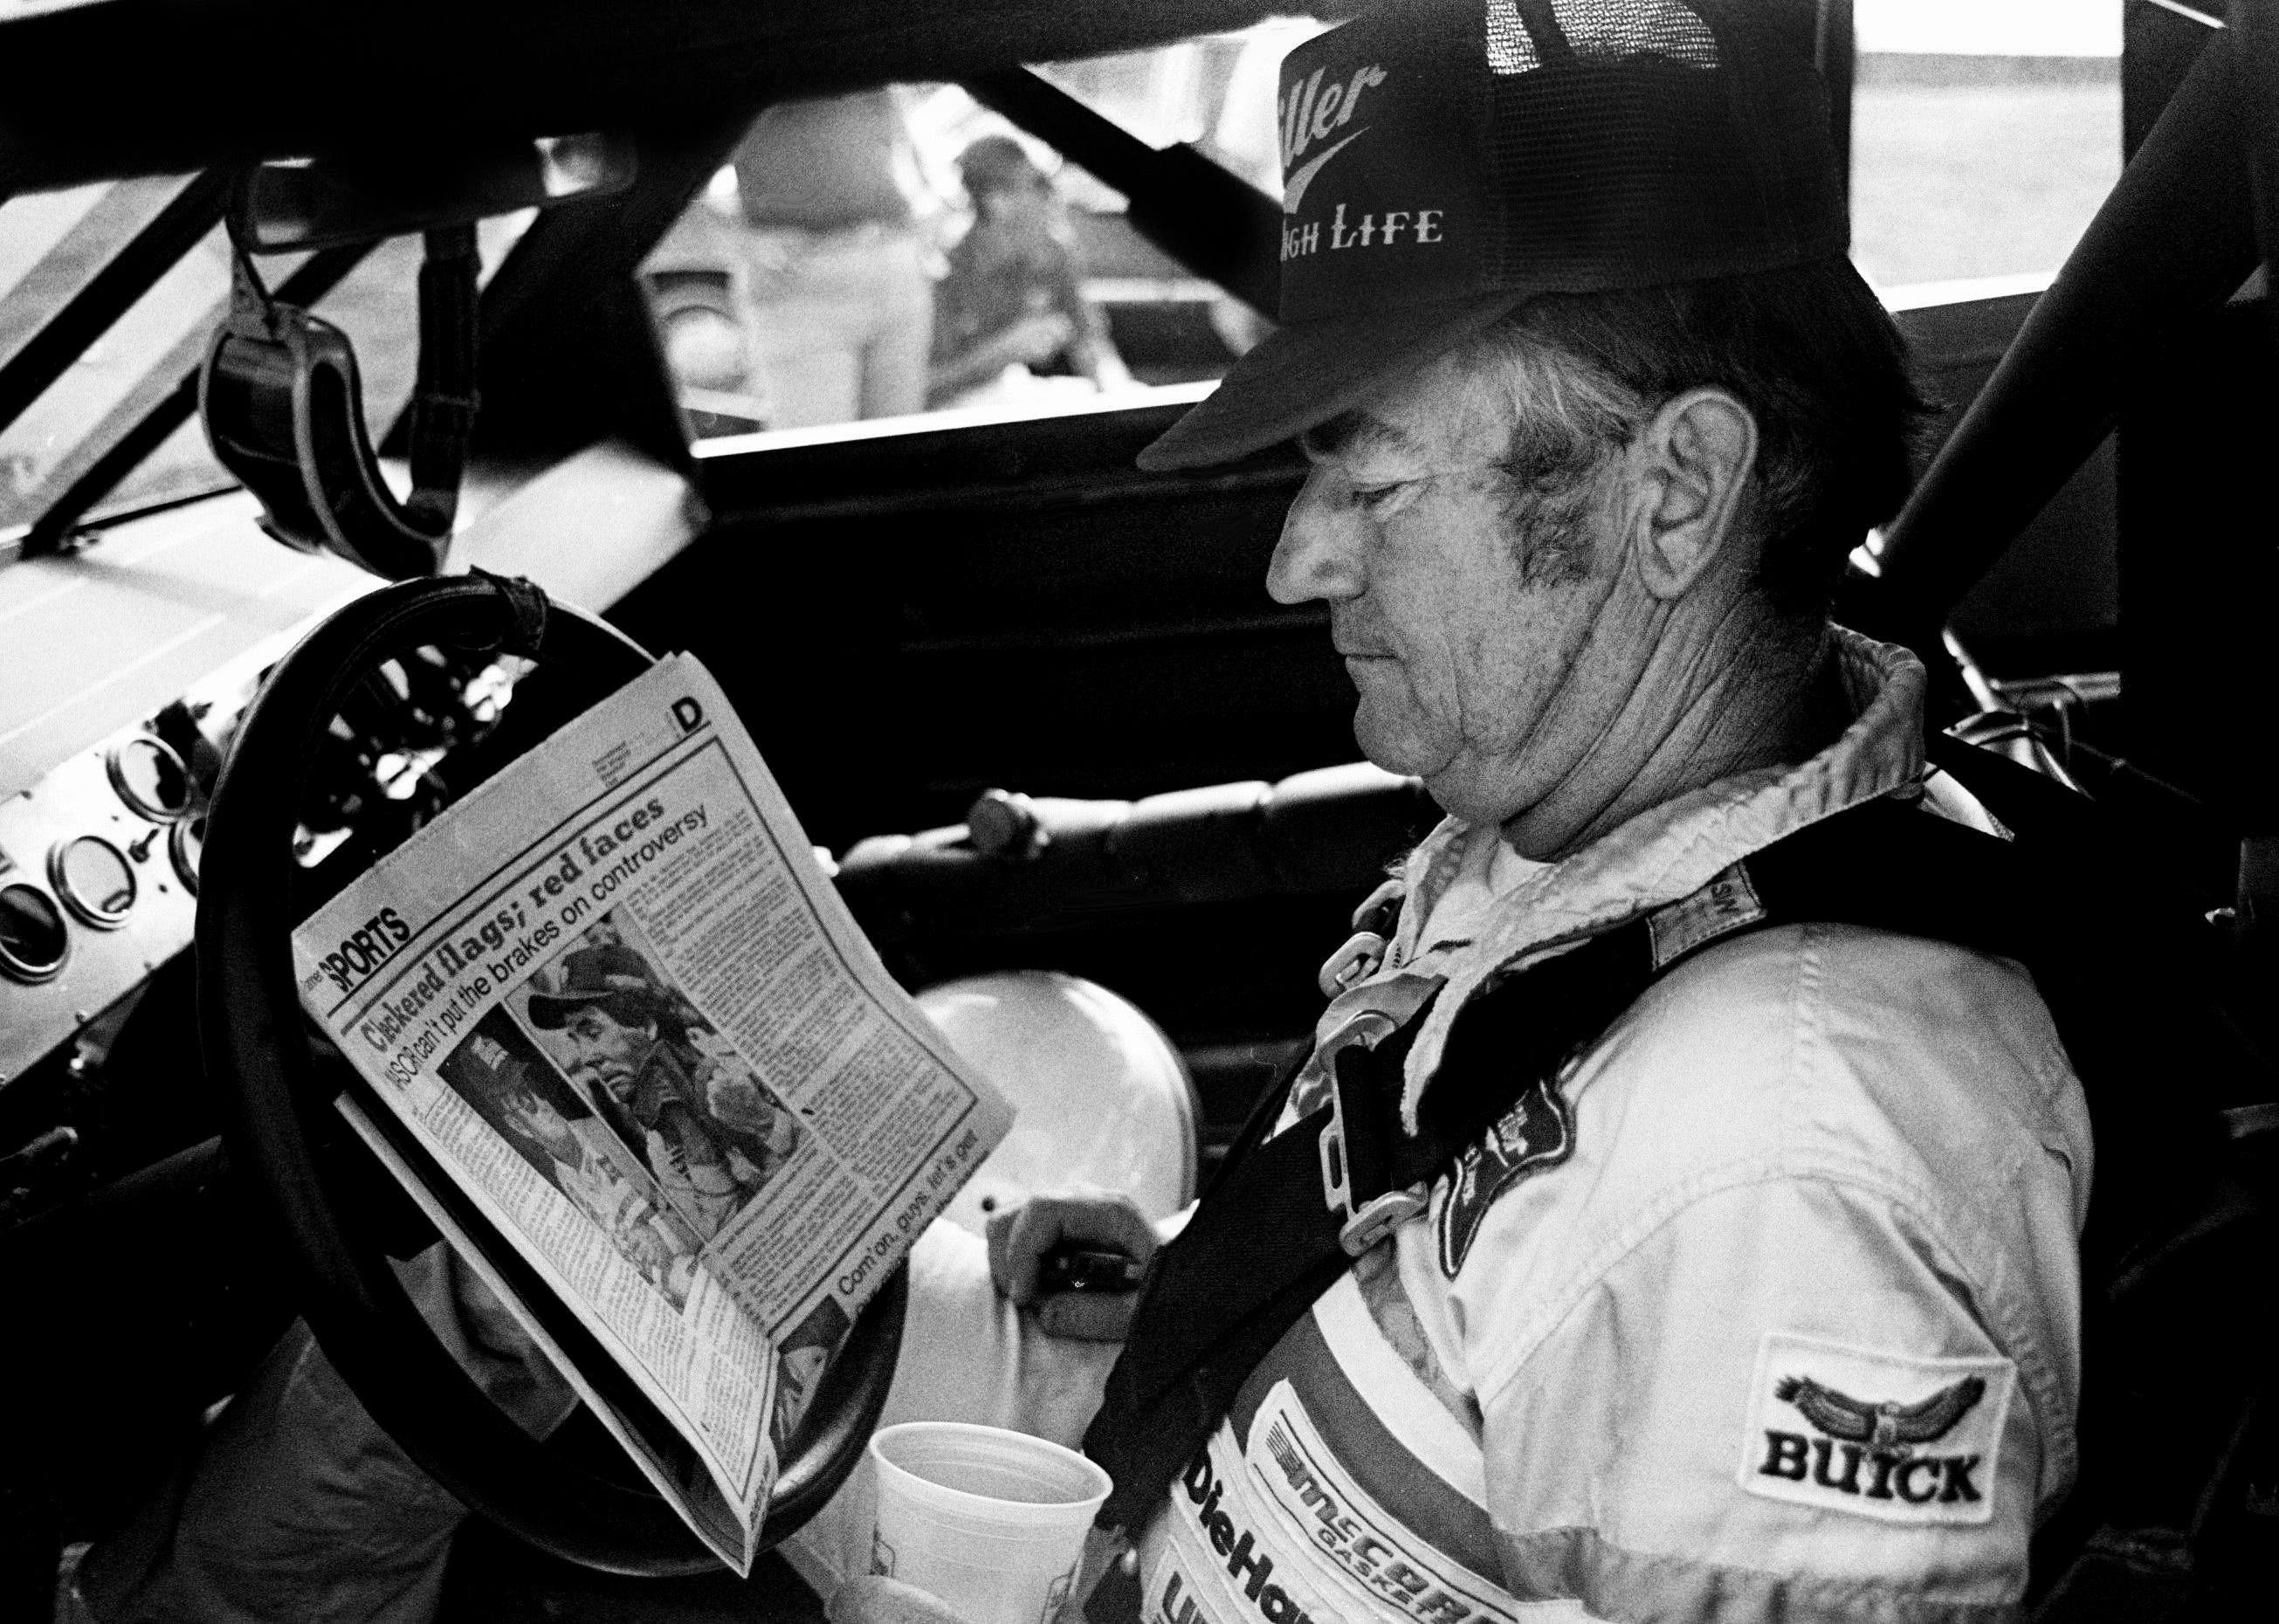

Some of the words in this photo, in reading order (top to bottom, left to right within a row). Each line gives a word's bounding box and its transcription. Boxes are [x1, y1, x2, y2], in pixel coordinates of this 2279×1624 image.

[1278, 63, 1387, 168] iller
[1280, 218, 1319, 262] IGH
[1331, 203, 1442, 250] LIFE
[671, 696, 703, 733] D
[412, 1018, 449, 1059] can't
[438, 998, 468, 1036] put
[457, 976, 492, 1009] the
[485, 919, 561, 984] brakes
[560, 896, 592, 925] on
[590, 803, 709, 901] controversy
[435, 900, 527, 979] flags;
[528, 852, 583, 908] red
[579, 797, 665, 866] faces
[318, 906, 410, 994] SPORTS
[1758, 1429, 1982, 1504] BUICK
[1182, 1448, 1314, 1624] DieHa
